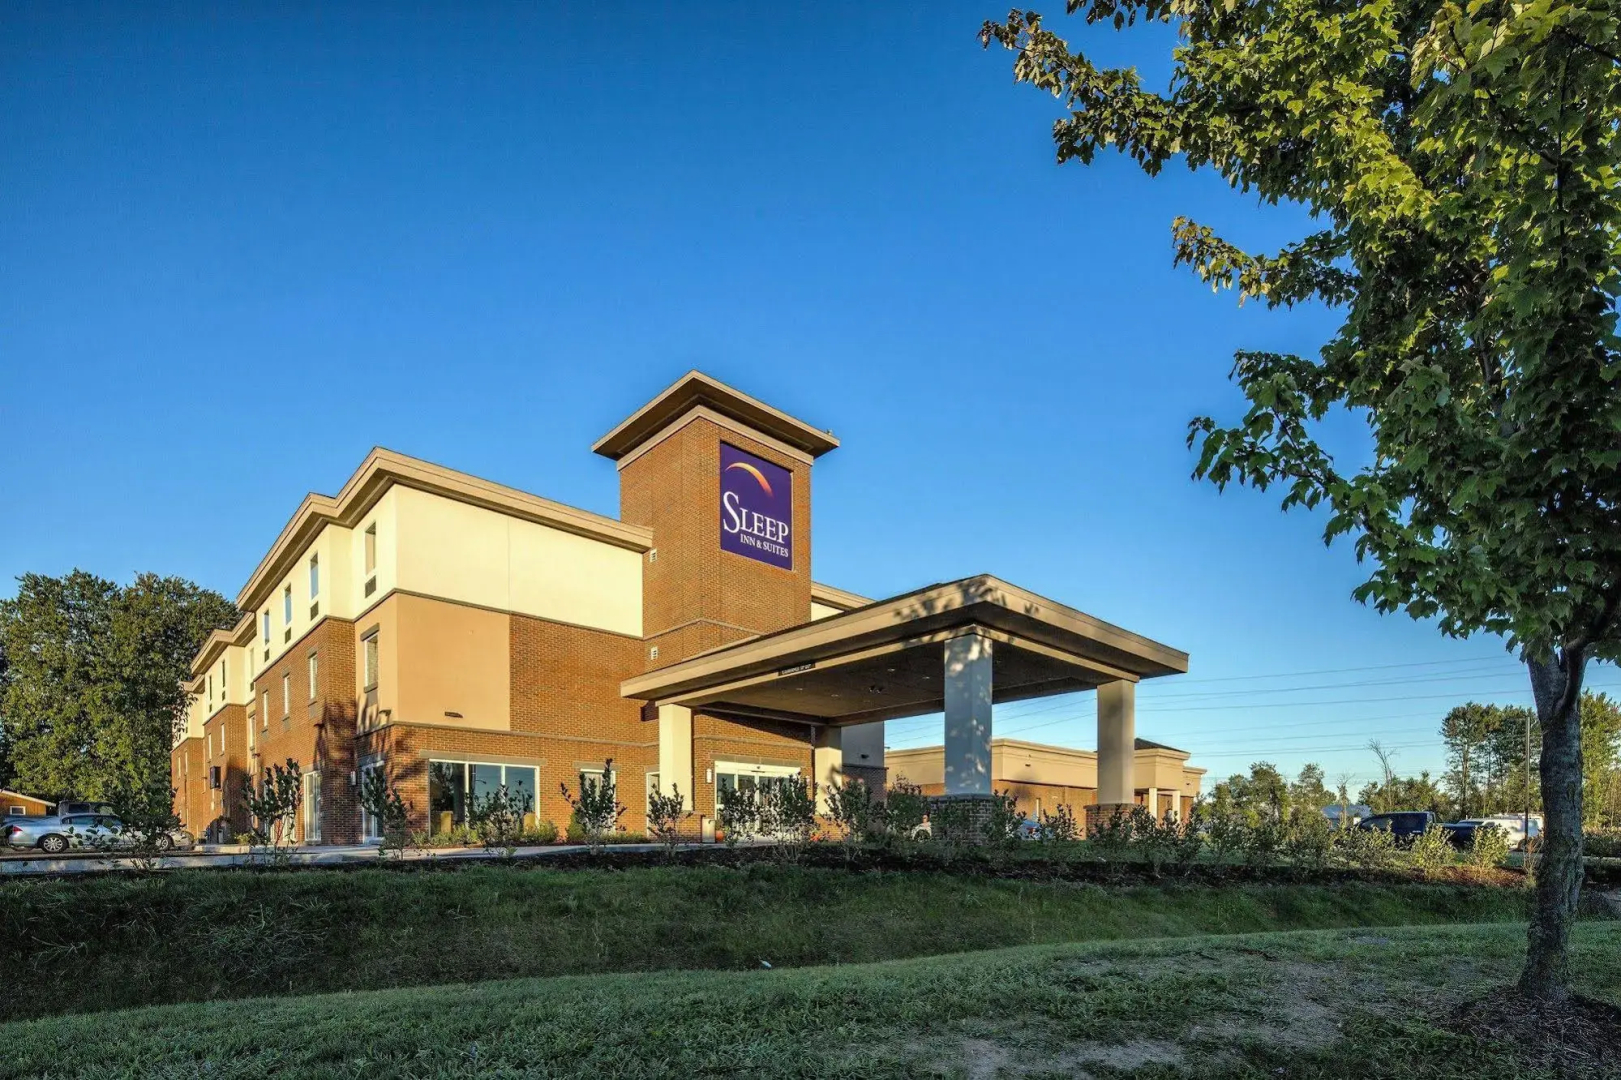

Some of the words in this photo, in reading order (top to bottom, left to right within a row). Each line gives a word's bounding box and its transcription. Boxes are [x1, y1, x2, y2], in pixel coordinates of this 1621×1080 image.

[723, 491, 789, 544] SLEEP
[740, 534, 755, 547] INN
[756, 540, 762, 549] &
[763, 541, 789, 557] SUITES
